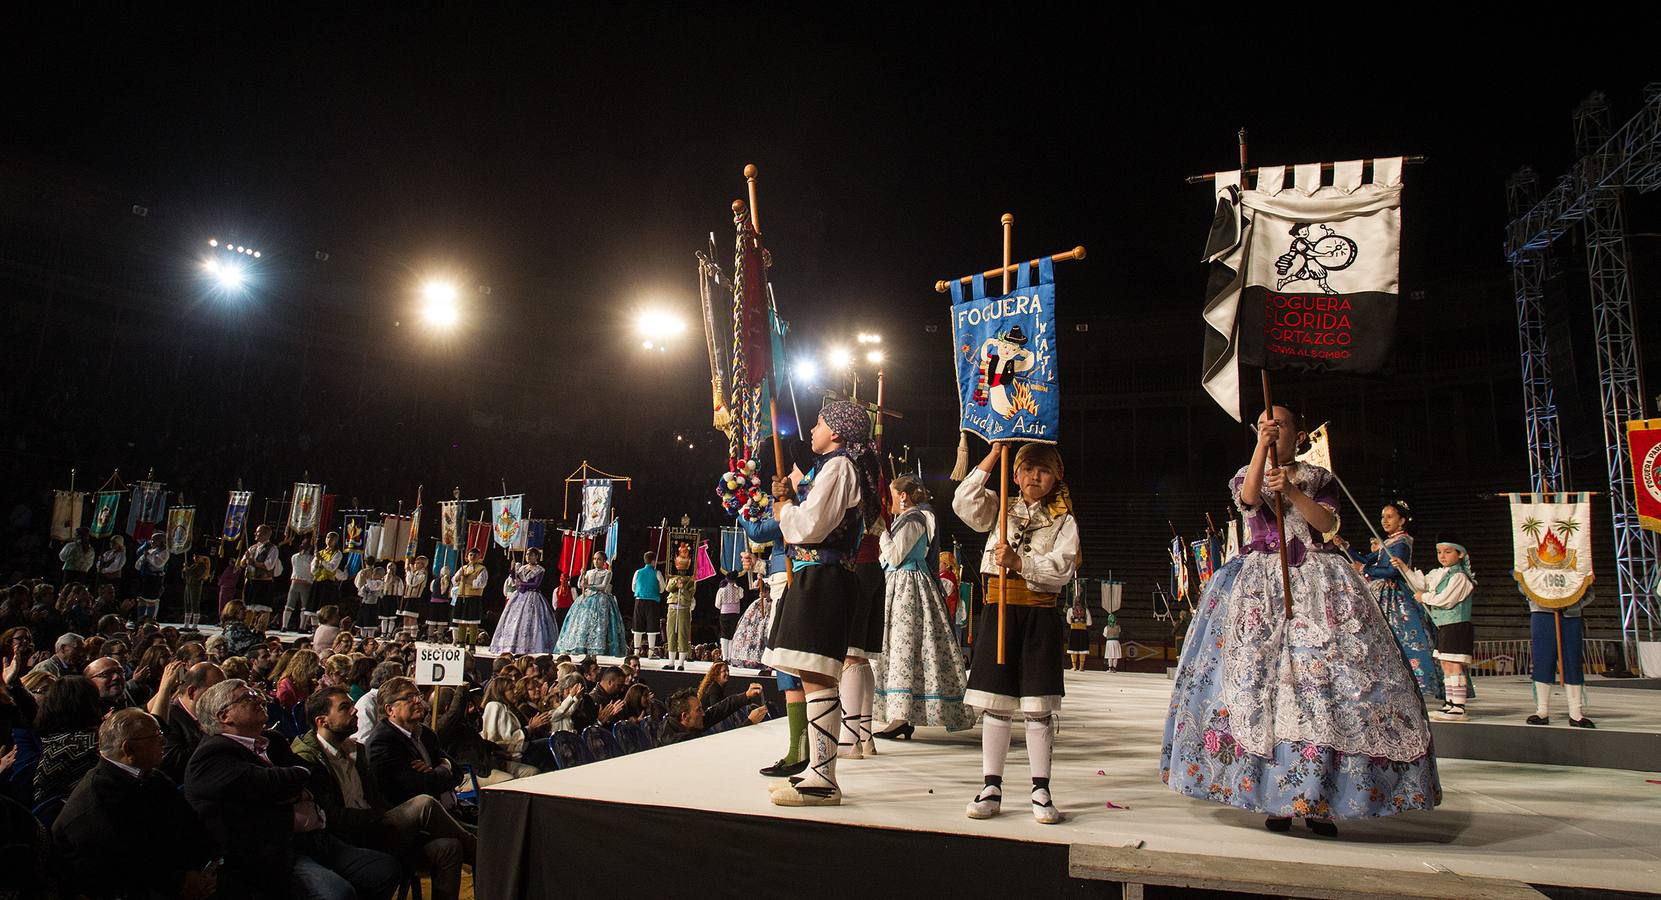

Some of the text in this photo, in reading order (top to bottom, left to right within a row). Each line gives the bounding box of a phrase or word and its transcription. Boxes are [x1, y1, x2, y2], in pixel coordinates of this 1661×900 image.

[958, 294, 1042, 329] FOGUERA
[1011, 415, 1047, 435] Asis
[421, 649, 461, 661] SECTOR
[432, 663, 446, 682] D
